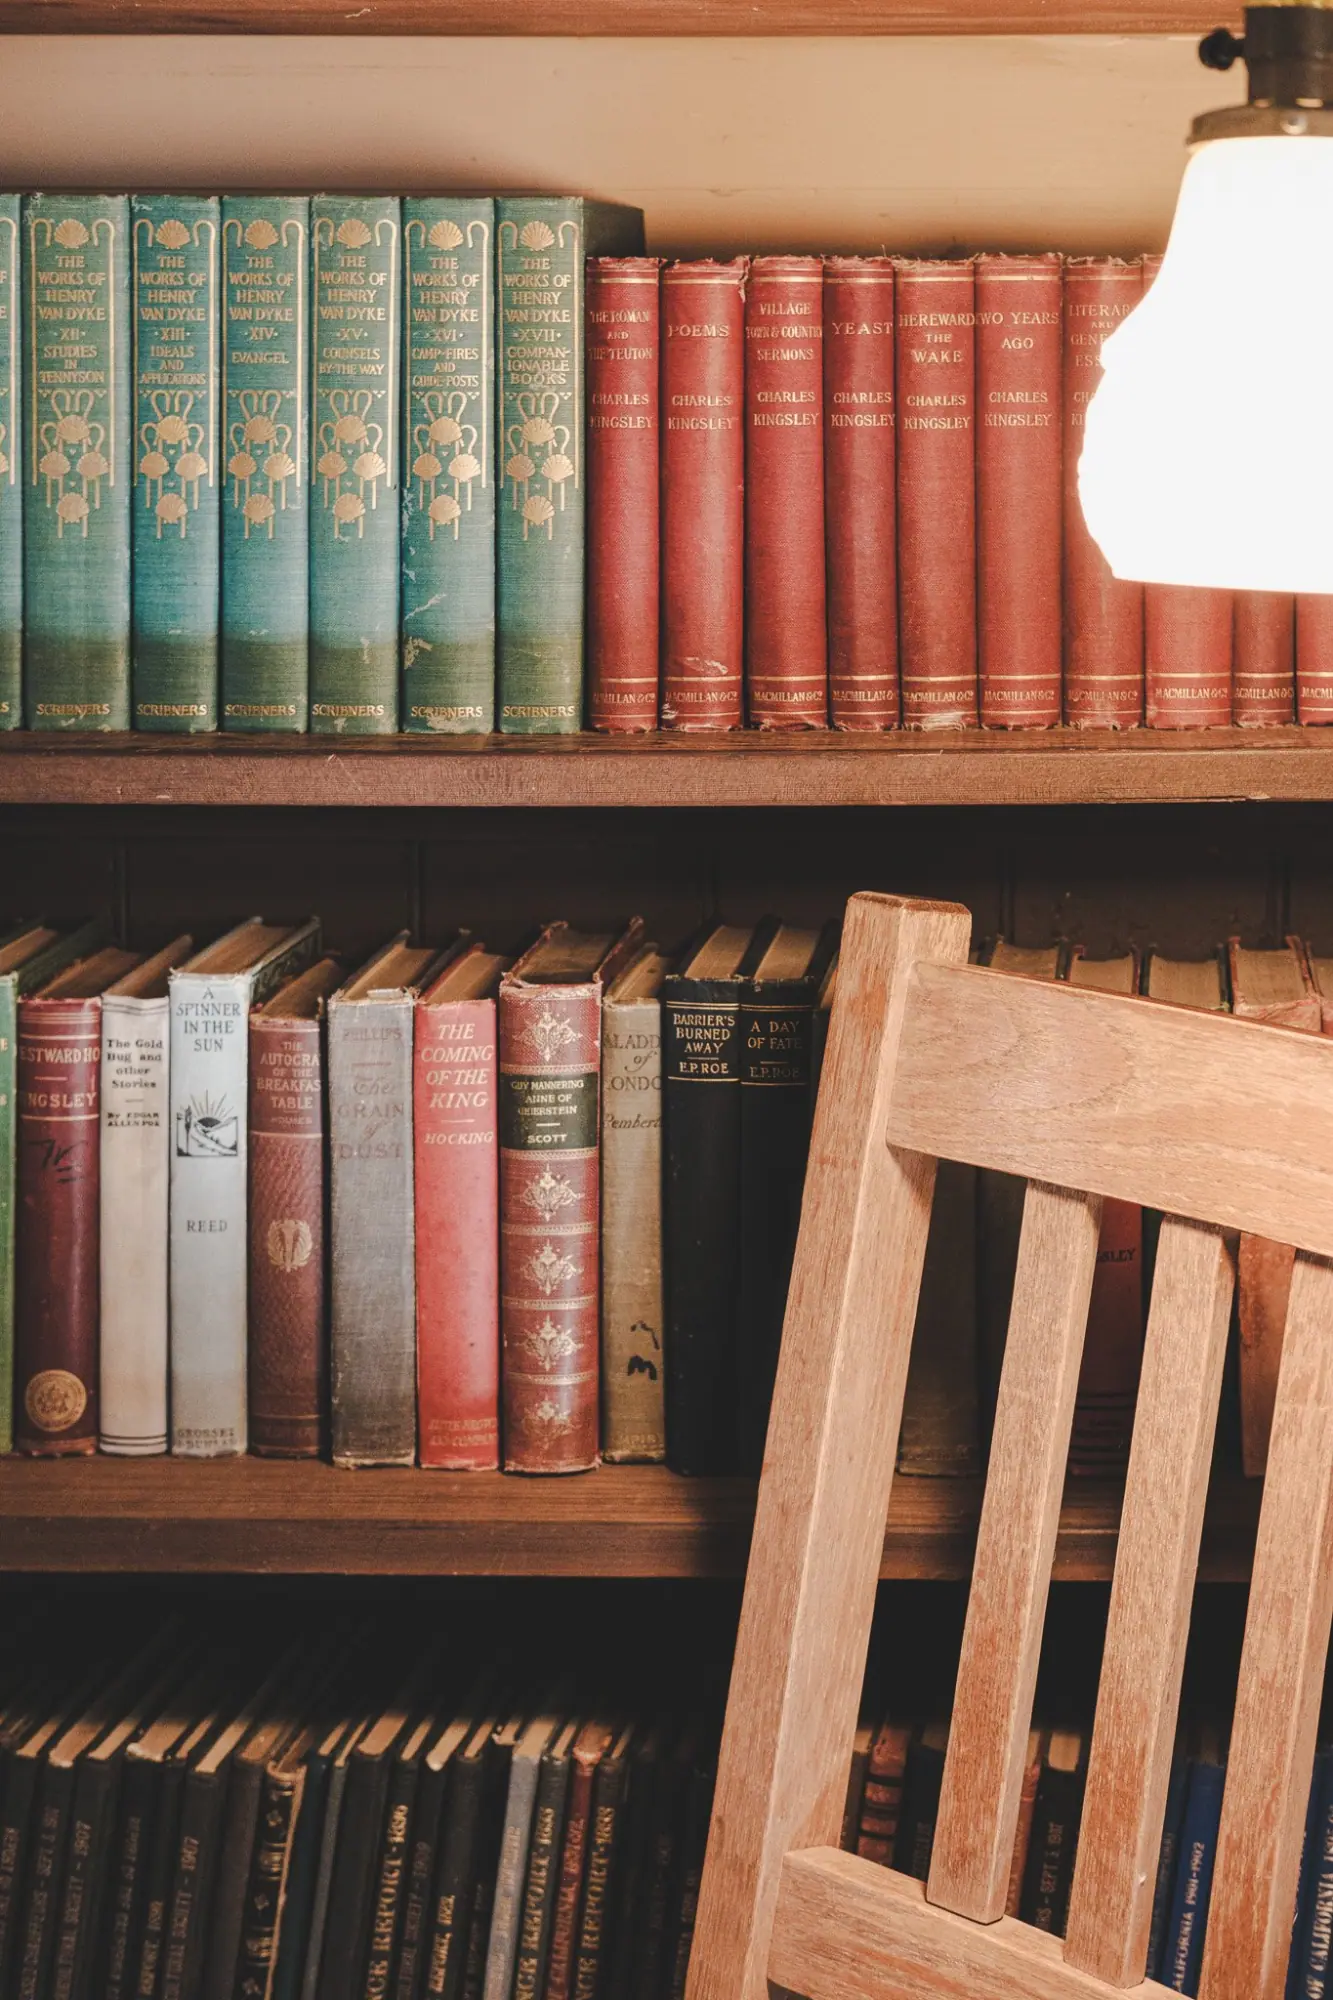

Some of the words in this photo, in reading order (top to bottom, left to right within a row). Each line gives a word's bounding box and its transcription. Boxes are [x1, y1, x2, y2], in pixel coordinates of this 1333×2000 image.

[56, 256, 85, 268] THE
[158, 256, 185, 268] THE
[246, 256, 273, 268] THE
[340, 256, 366, 268] THE
[431, 258, 459, 270] THE
[522, 258, 550, 270] THE
[38, 272, 83, 285] WORKS
[88, 272, 106, 285] OF
[140, 272, 184, 285] WORKS
[189, 272, 207, 286] OF
[229, 272, 272, 285] WORKS
[277, 272, 294, 286] OF
[320, 272, 365, 285] WORKS
[369, 272, 387, 285] OF
[413, 274, 457, 287] WORKS
[462, 274, 480, 287] OF
[504, 275, 549, 287] WORKS
[553, 275, 571, 287] OF
[46, 290, 97, 303] HENRY
[148, 290, 196, 303] HENRY
[236, 290, 285, 303] HENRY
[328, 290, 376, 303] HENRY
[420, 292, 470, 305] HENRY
[512, 292, 562, 305] HENRY
[38, 308, 61, 320] VAN
[67, 308, 106, 320] DYKE
[140, 308, 162, 321] VAN
[167, 308, 205, 320] DYKE
[229, 308, 252, 320] VAN
[256, 308, 293, 321] DYKE
[320, 308, 344, 320] VAN
[347, 308, 386, 321] DYKE
[760, 303, 812, 315] VILLAGE
[1069, 304, 1130, 316] LITERAR
[413, 310, 436, 322] VAN
[440, 310, 479, 322] DYKE
[506, 310, 528, 322] VAN
[532, 310, 571, 322] DYKE
[899, 313, 975, 327] HEREWARD
[1011, 312, 1060, 325] YEARS
[668, 325, 730, 337] POEMS
[771, 326, 780, 339] &
[832, 322, 892, 335] YEAST
[607, 331, 629, 340] AND
[926, 334, 952, 343] THE
[1001, 337, 1034, 349] AGO
[44, 347, 97, 358] STUDIES
[150, 347, 195, 358] IDEALS
[232, 352, 290, 364] EVANGEL
[323, 348, 380, 360] COUNSELS
[608, 348, 653, 360] TEUTON
[757, 348, 813, 361] SERMONS
[912, 350, 963, 363] WAKE
[64, 360, 77, 369] IN
[159, 360, 184, 370] AND
[433, 362, 456, 373] AND
[508, 360, 569, 372] IONABLE
[40, 371, 104, 383] TENNYSON
[510, 373, 566, 385] BOOKS
[592, 394, 649, 405] CHARLES
[672, 396, 732, 407] CHARLES
[757, 391, 816, 403] CHARLES
[834, 392, 891, 404] CHARLES
[907, 395, 966, 407] CHARLES
[988, 391, 1048, 403] CHARLES
[668, 417, 737, 430] KINGSLEY
[754, 413, 819, 426] KINGSLEY
[831, 414, 895, 427] KINGSLEY
[904, 417, 971, 430] KINGSLEY
[984, 414, 1052, 426] KINGSLEY
[203, 987, 214, 1000] A
[176, 1002, 241, 1017] SPINNER
[674, 1014, 735, 1027] BARRIER'S
[184, 1021, 206, 1035] IN
[208, 1021, 234, 1035] THE
[438, 1023, 475, 1039] THE
[751, 1021, 761, 1033] A
[769, 1021, 800, 1033] DAY
[676, 1028, 731, 1040] BURNED
[107, 1039, 130, 1048] The
[135, 1039, 163, 1050] Gold
[194, 1038, 223, 1052] SUN
[282, 1041, 303, 1051] THE
[684, 1042, 724, 1054] AWAY
[747, 1037, 764, 1050] OF
[770, 1038, 802, 1050] FATE
[19, 1047, 81, 1063] ESTWARD
[107, 1052, 132, 1063] Bug
[140, 1053, 161, 1061] and
[260, 1052, 320, 1067] AUTOCRA
[421, 1045, 494, 1062] COMING
[624, 1050, 658, 1073] of
[116, 1066, 150, 1075] other
[272, 1068, 288, 1077] OF
[292, 1068, 313, 1077] THE
[426, 1069, 450, 1085] OF
[453, 1068, 490, 1085] THE
[112, 1080, 156, 1089] Stories
[256, 1078, 321, 1092] BREAKFAS
[511, 1081, 529, 1091] GUY
[531, 1079, 584, 1090] MANNERING
[271, 1096, 313, 1109] TABLE
[430, 1092, 488, 1108] KING
[525, 1094, 554, 1103] ANNE
[557, 1093, 572, 1103] OF
[337, 1103, 404, 1118] GRAIN
[424, 1131, 493, 1144] HOCKING
[527, 1134, 568, 1144] SCOTT
[186, 1220, 228, 1233] REED
[371, 1854, 402, 1951] REPORT
[580, 1854, 611, 1951] REPORT
[1305, 1972, 1324, 2000] OF
